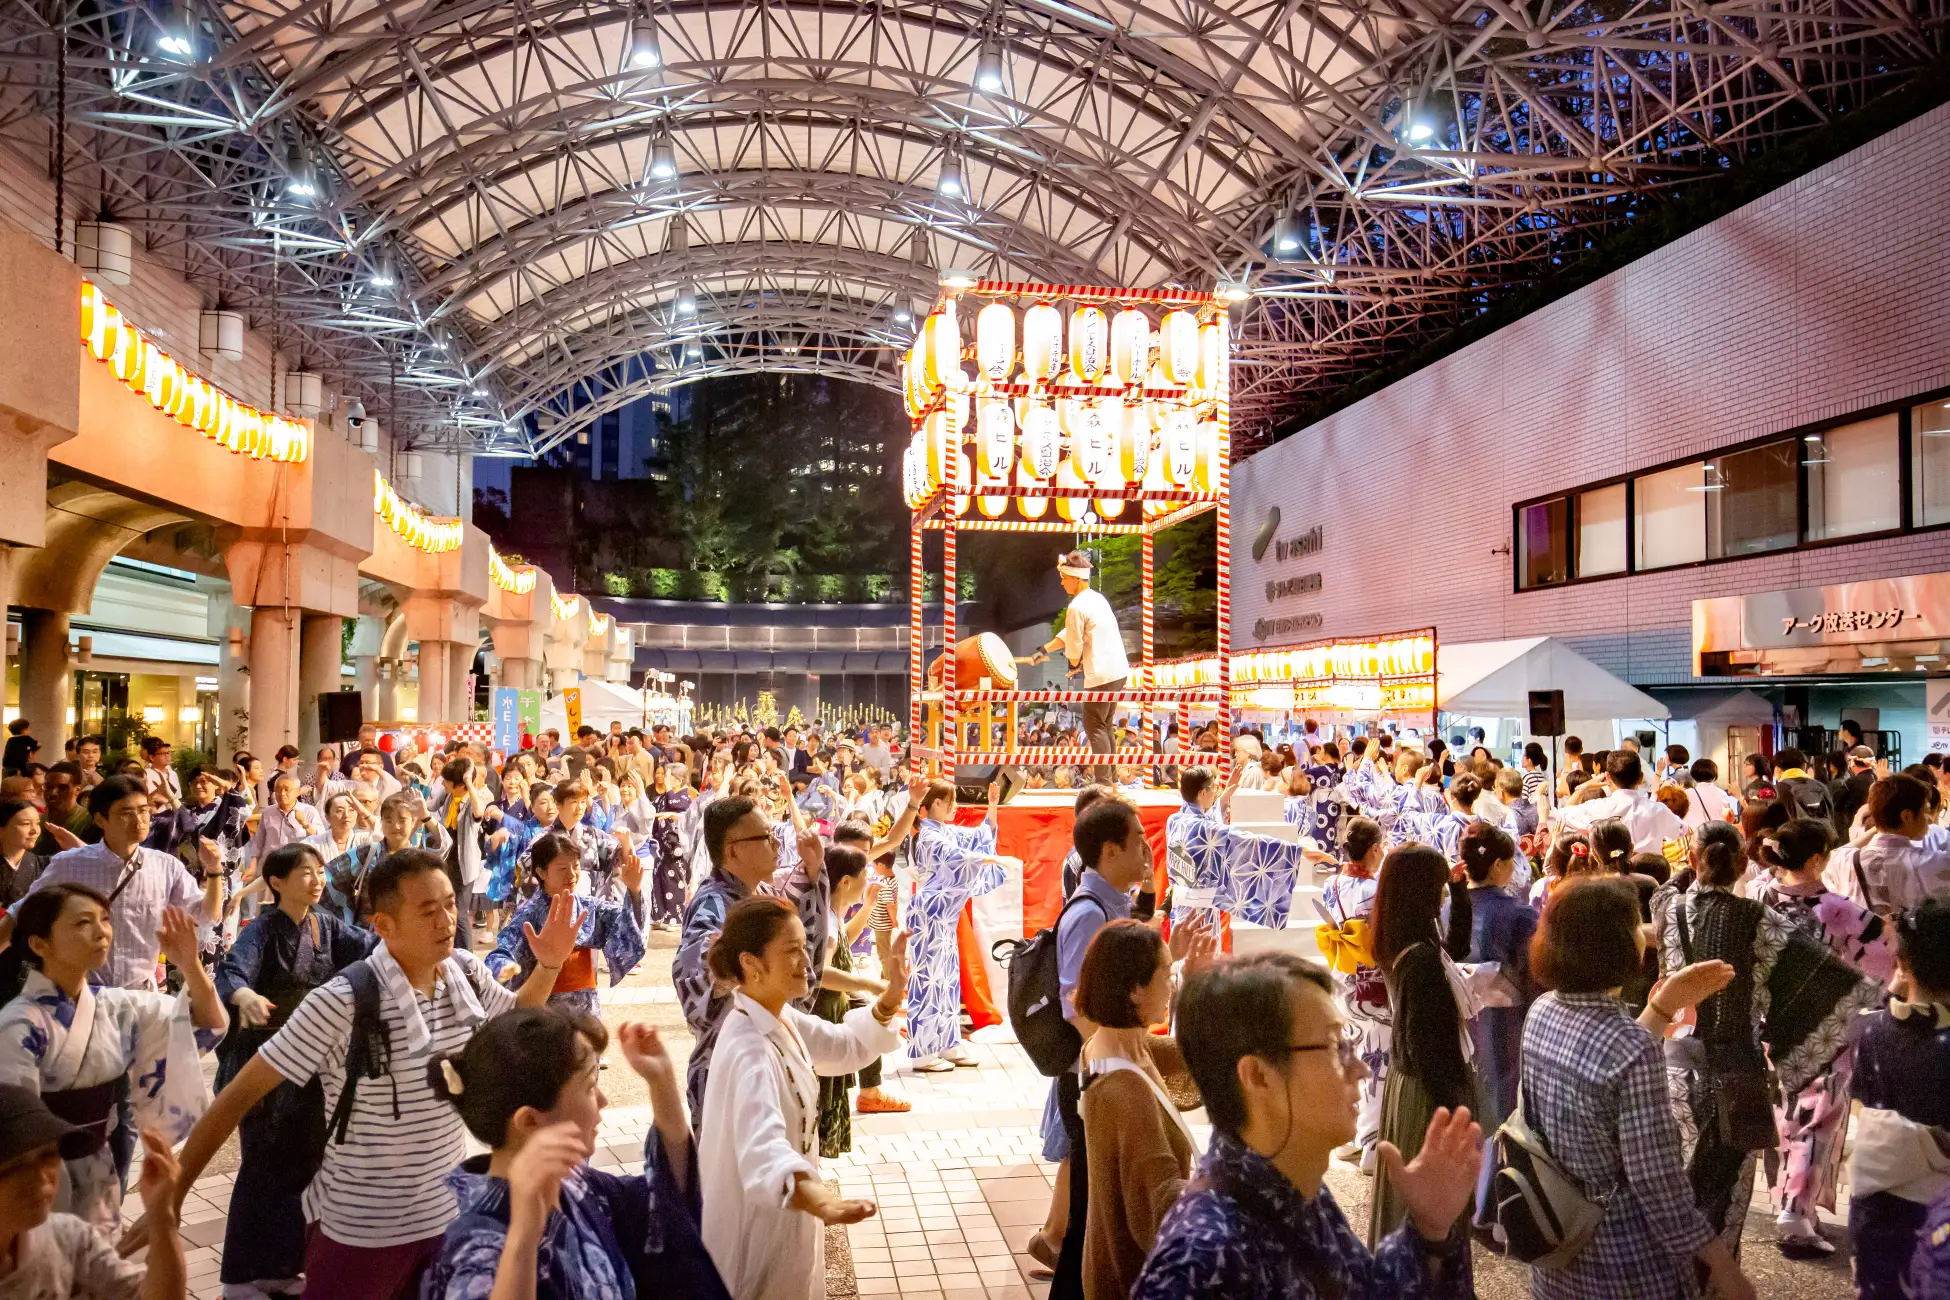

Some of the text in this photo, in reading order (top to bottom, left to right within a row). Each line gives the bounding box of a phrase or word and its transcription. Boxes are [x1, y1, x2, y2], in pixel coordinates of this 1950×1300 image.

[1781, 607, 1922, 636] アーク放送センター
